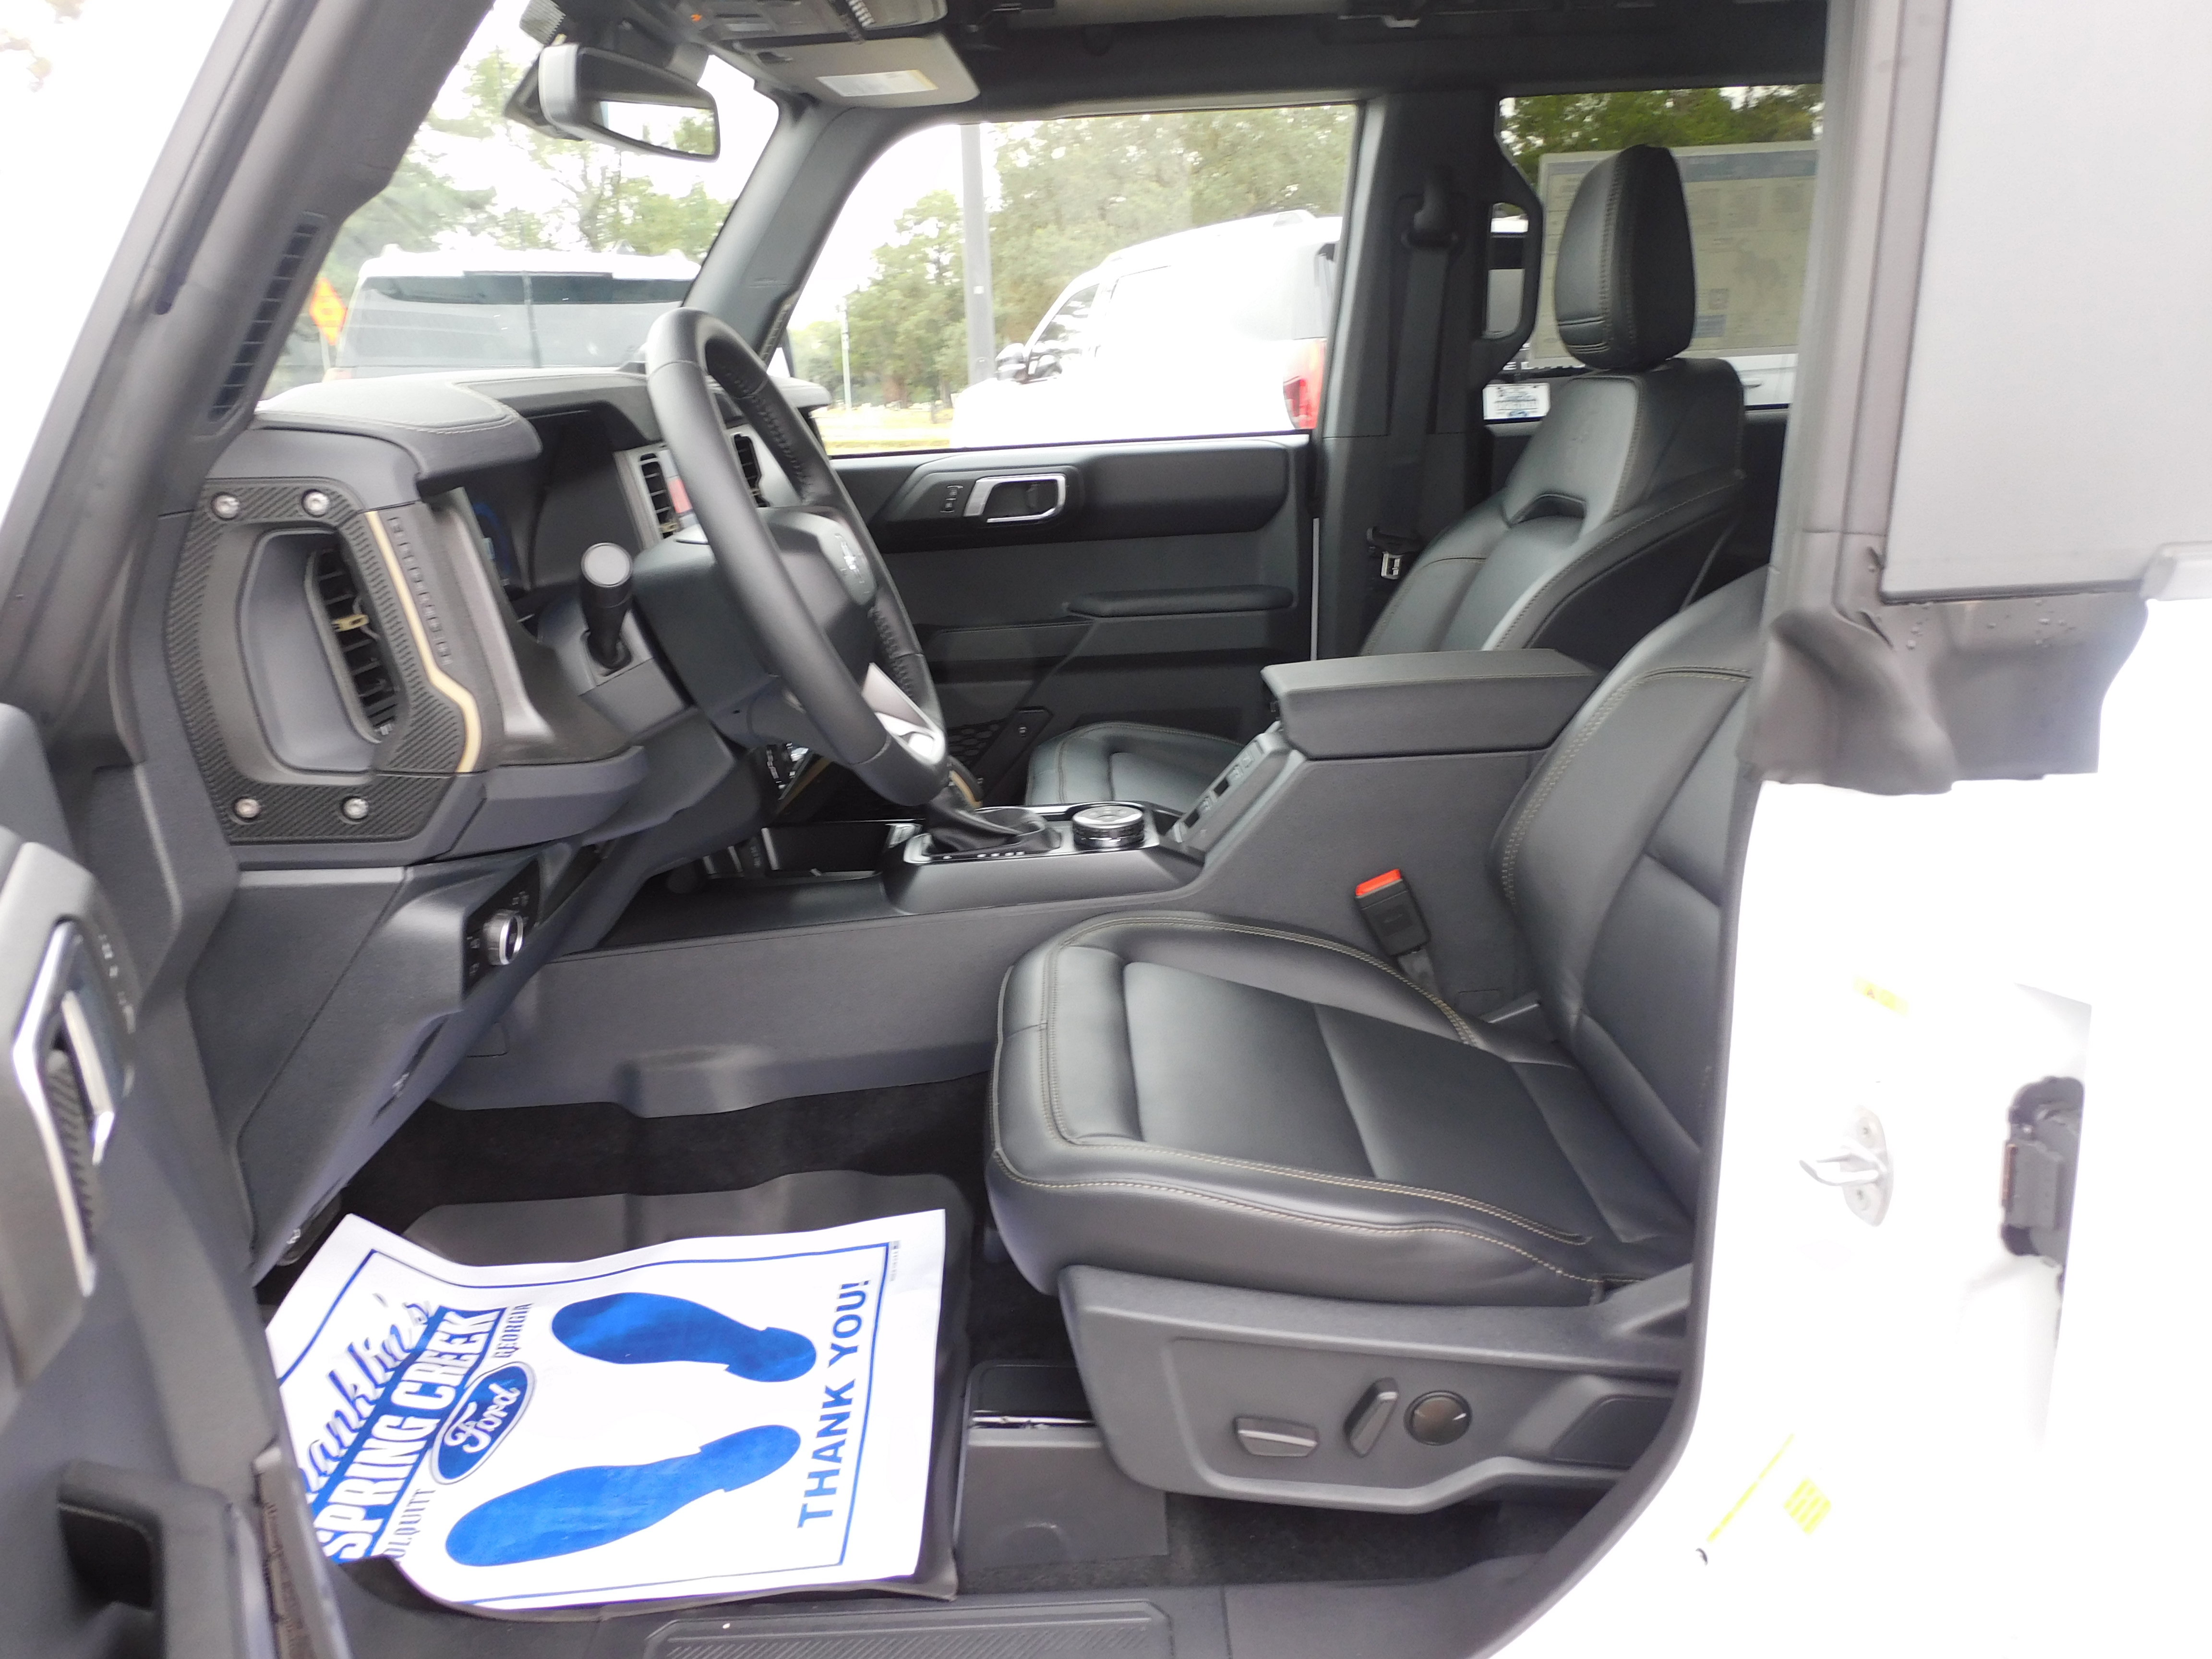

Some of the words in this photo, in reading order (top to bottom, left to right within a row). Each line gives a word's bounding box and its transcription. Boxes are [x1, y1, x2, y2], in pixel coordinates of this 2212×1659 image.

[492, 1303, 534, 1358] GEORGIA
[797, 1378, 856, 1528] THANK
[827, 1280, 871, 1368] YOU!
[313, 1414, 441, 1560] SPRING
[390, 1310, 502, 1410] CREEK
[443, 1382, 521, 1453] Ford
